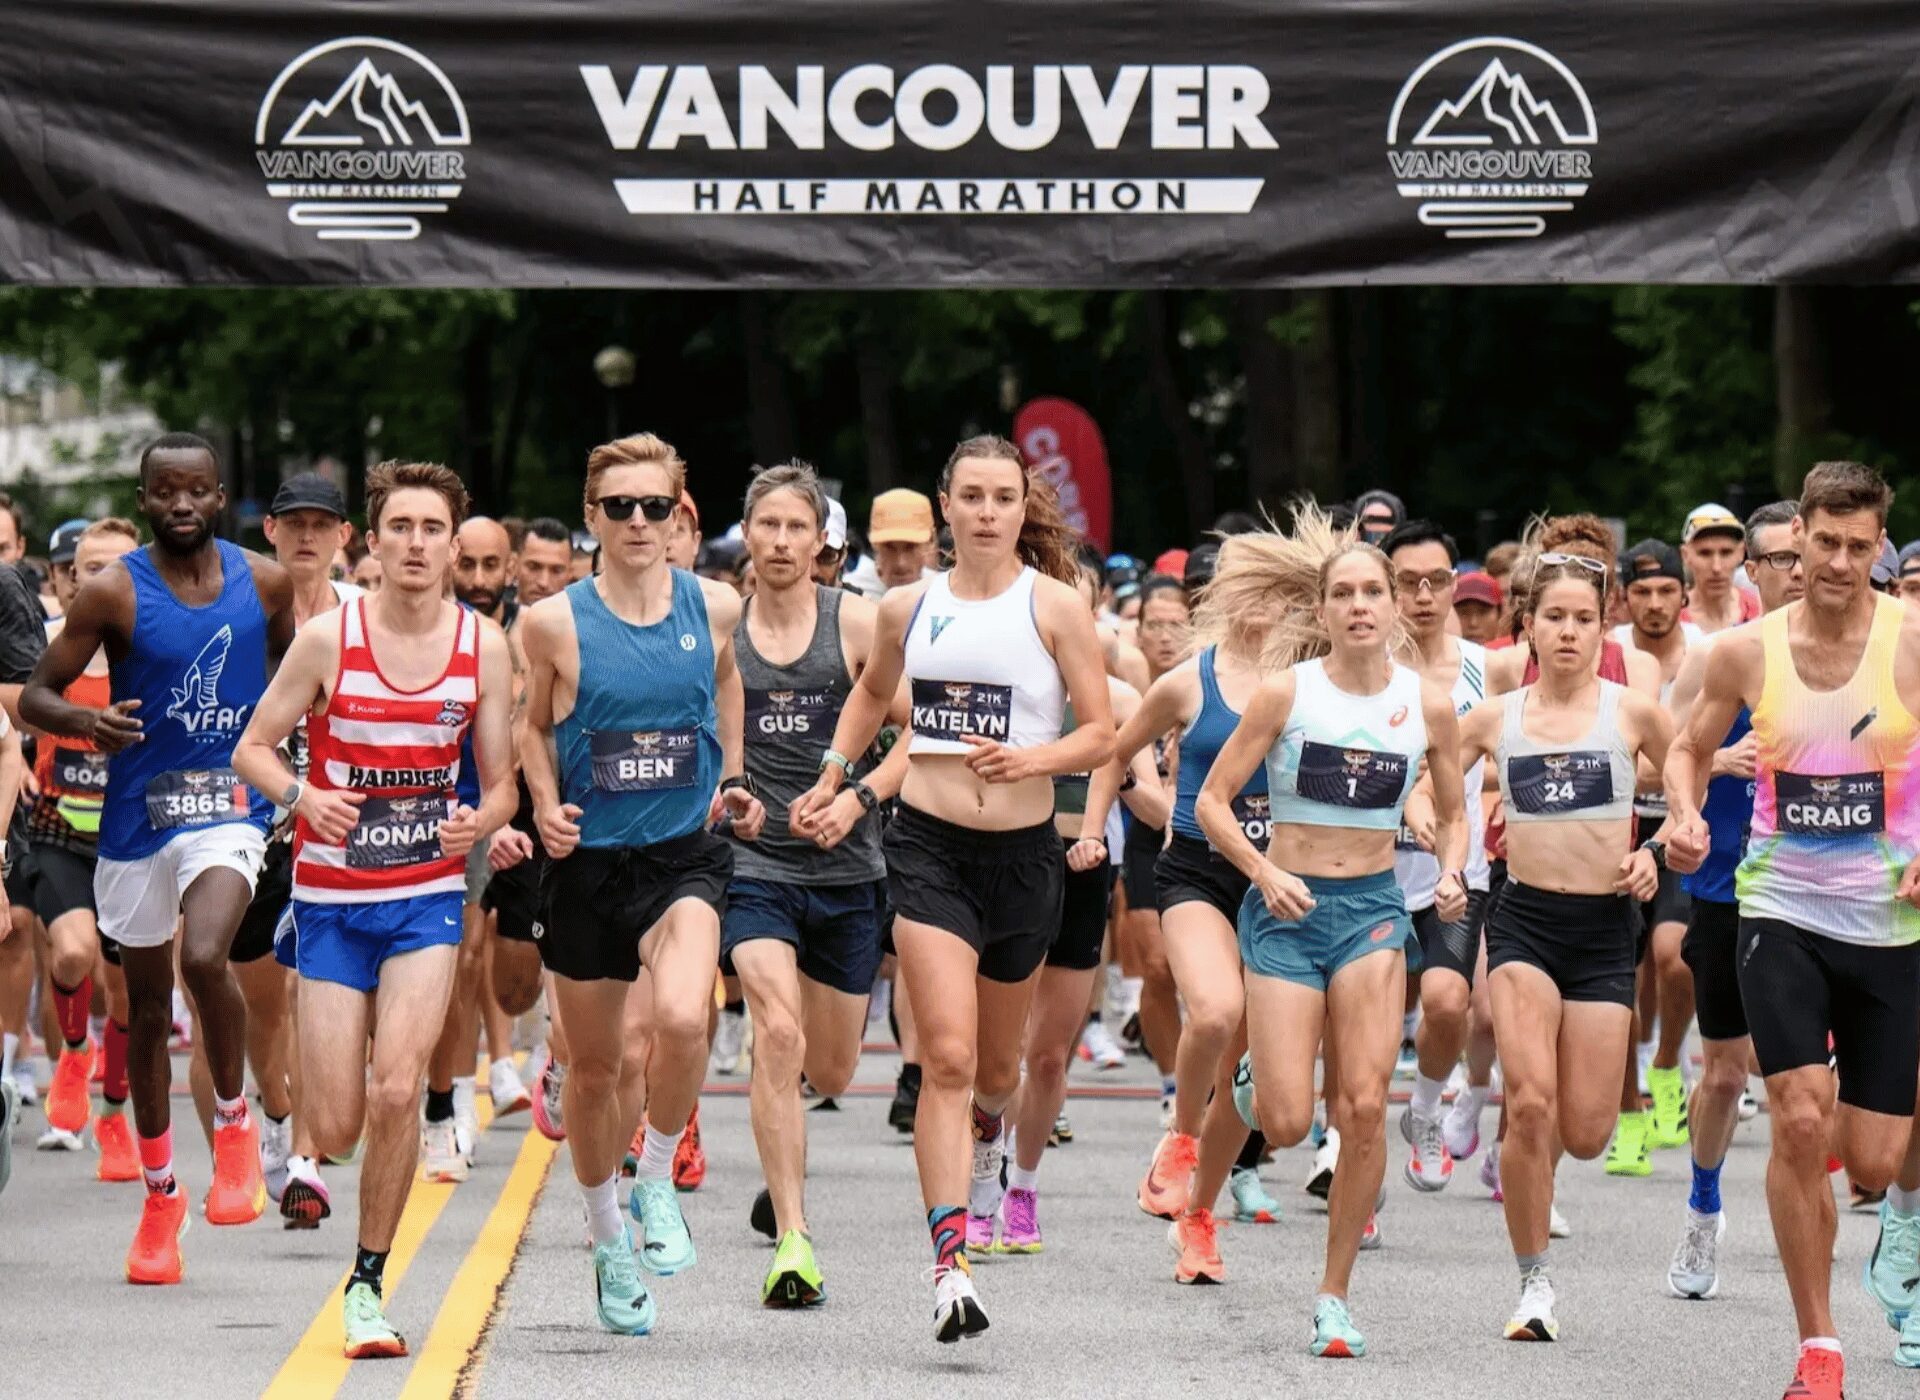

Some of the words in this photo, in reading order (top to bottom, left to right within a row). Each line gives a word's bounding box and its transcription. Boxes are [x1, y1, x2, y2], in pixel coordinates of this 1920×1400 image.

[579, 64, 1280, 151] VANCOUVER
[256, 151, 467, 179] VANCOUVER
[1387, 151, 1593, 178] VANCOUVER
[693, 182, 829, 211] HALF
[864, 182, 1188, 211] MARATHON
[801, 694, 823, 705] 21K
[977, 692, 1001, 704] 21K
[759, 714, 810, 733] GUS
[913, 706, 1006, 735] KATELYN
[668, 735, 690, 746] 21K
[619, 758, 674, 779] BEN
[1376, 761, 1399, 772] 21K
[1577, 759, 1601, 770] 21K
[216, 775, 240, 786] 21K
[1347, 778, 1357, 798] 1
[1848, 782, 1874, 794] 21K
[1544, 781, 1576, 802] 24
[166, 793, 231, 815] 3865
[422, 798, 440, 812] 21K
[1786, 803, 1872, 827] CRAIG
[354, 819, 442, 846] JONAH
